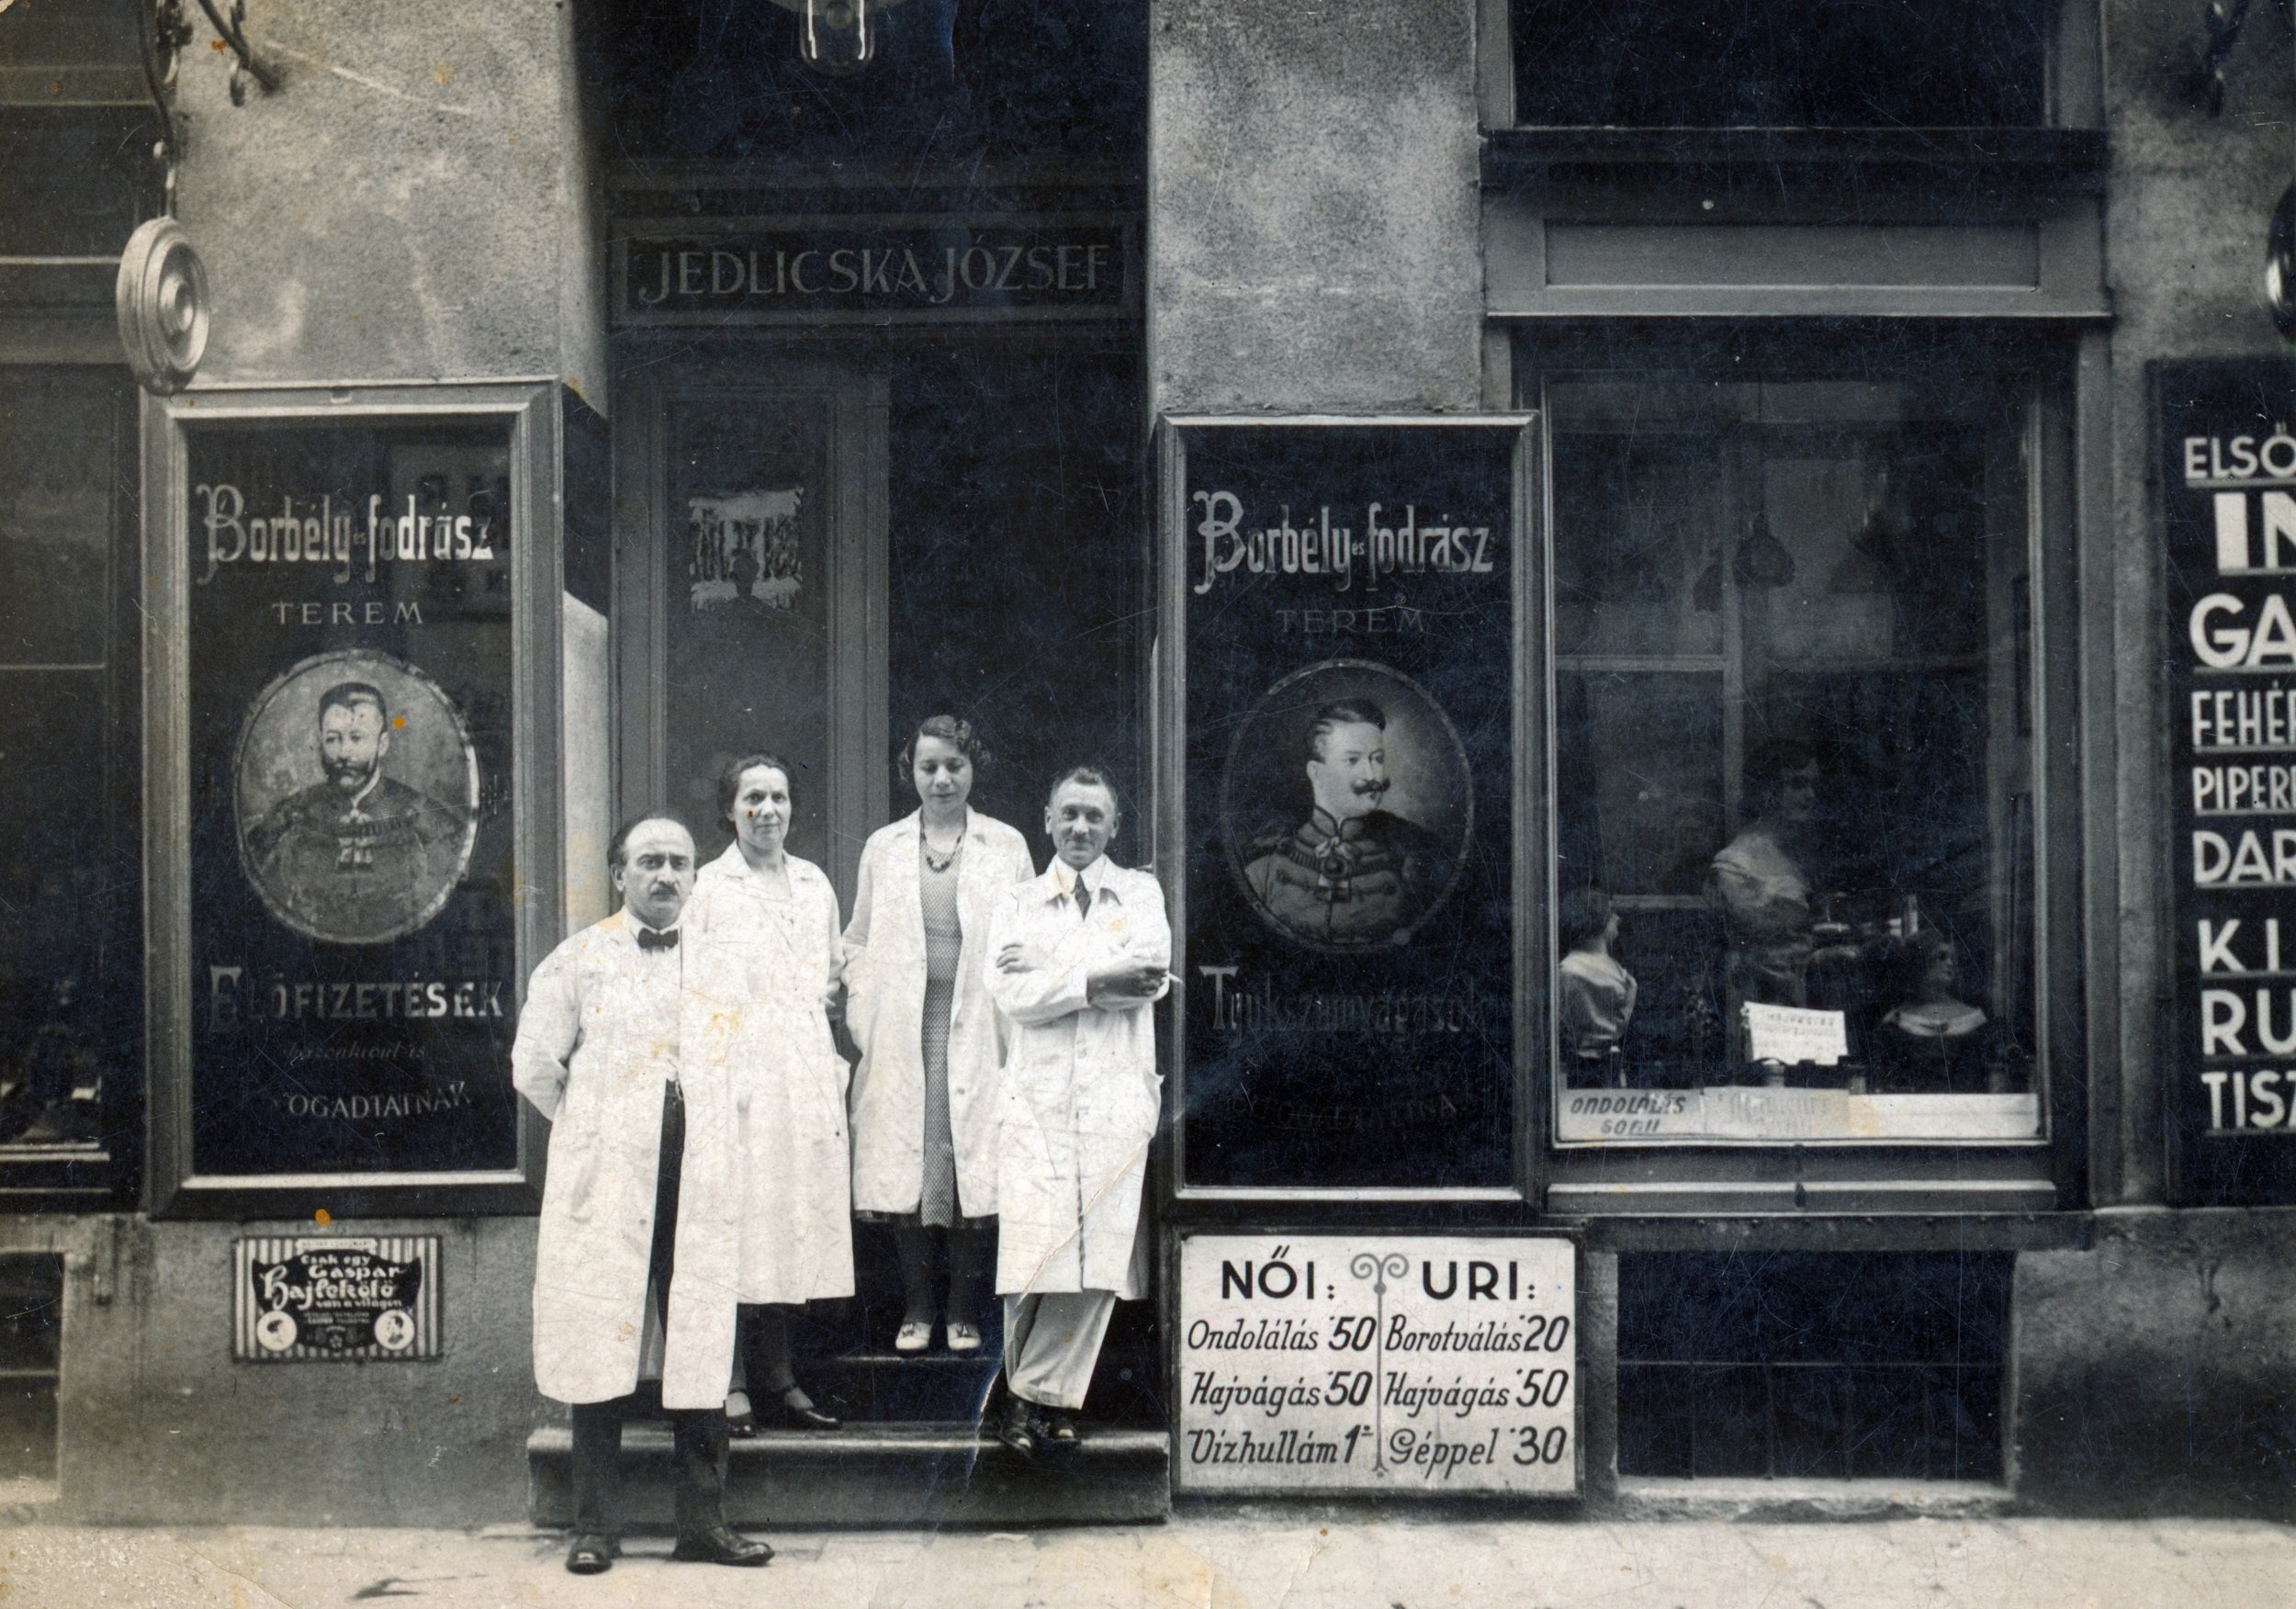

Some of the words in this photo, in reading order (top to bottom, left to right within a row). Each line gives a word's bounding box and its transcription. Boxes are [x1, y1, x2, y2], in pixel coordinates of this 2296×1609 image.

[638, 248, 928, 304] JEDLICSKA
[929, 234, 1109, 304] JÓZSEF
[2185, 422, 2296, 478] ELSŐ
[196, 484, 351, 585] Borbély
[366, 493, 494, 583] fodrász
[1193, 490, 1351, 595] Borbély
[1367, 501, 1494, 592] fodrász
[272, 602, 424, 625] TEREM
[1275, 610, 1424, 634] TEREM
[2189, 592, 2296, 669] GA
[2192, 765, 2296, 811] PIPER
[2201, 988, 2296, 1056] RU
[1221, 1244, 1335, 1300] NŐI:
[1422, 1260, 1536, 1301] URI:
[1187, 1317, 1319, 1351] Ondolálás
[1384, 1313, 1523, 1352] Borotválás
[1190, 1370, 1322, 1418] Hajvágás
[1383, 1370, 1511, 1418] Hajvágás
[1187, 1427, 1338, 1465] Vízhullám
[1389, 1426, 1500, 1480] Géppel
